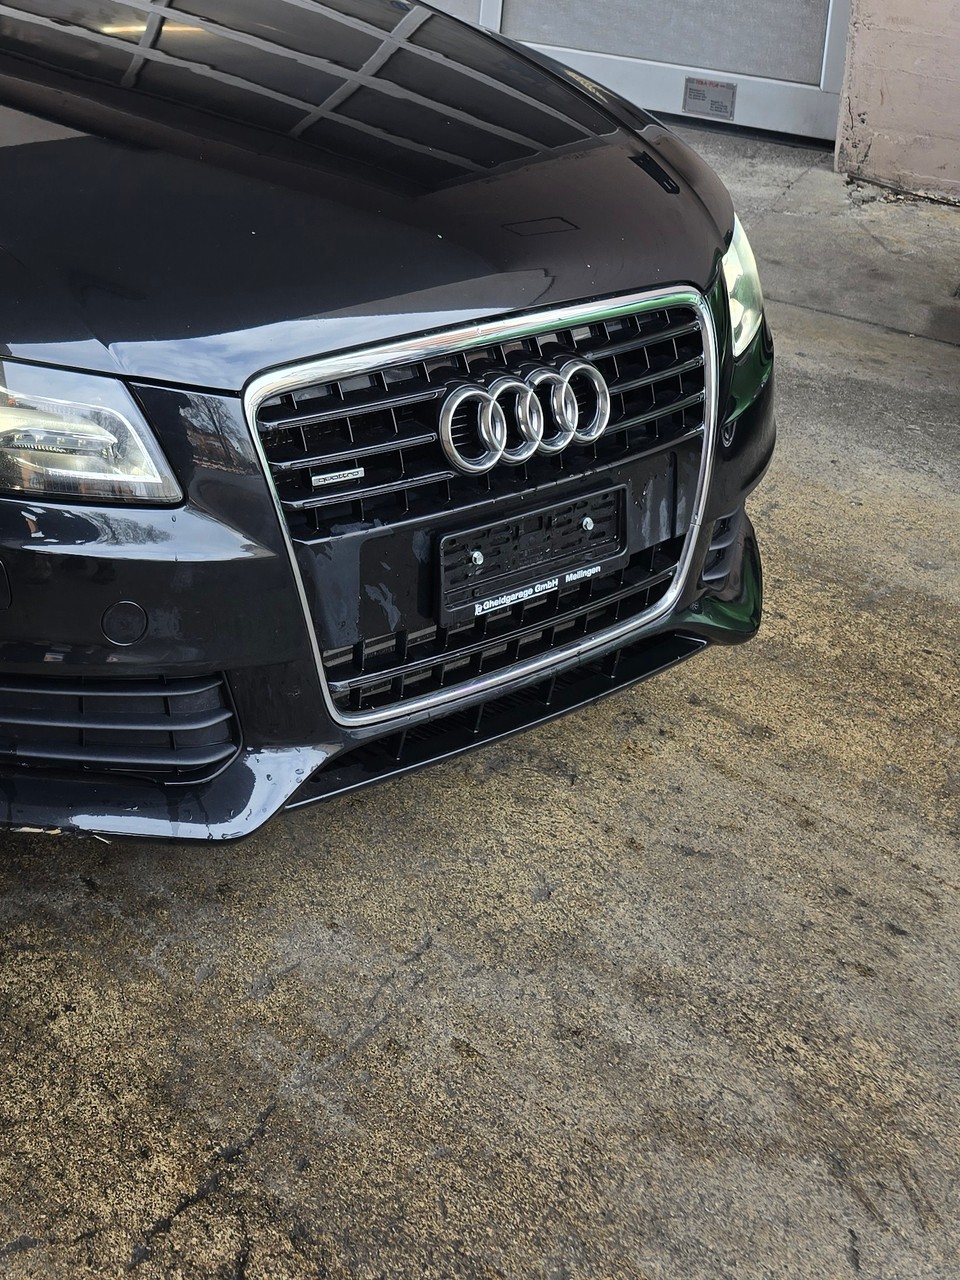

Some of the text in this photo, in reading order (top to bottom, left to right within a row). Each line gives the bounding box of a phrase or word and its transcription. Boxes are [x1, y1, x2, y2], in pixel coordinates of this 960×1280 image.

[319, 471, 359, 483] quattro
[534, 578, 558, 593] GmbH
[565, 565, 601, 583] Mellingen
